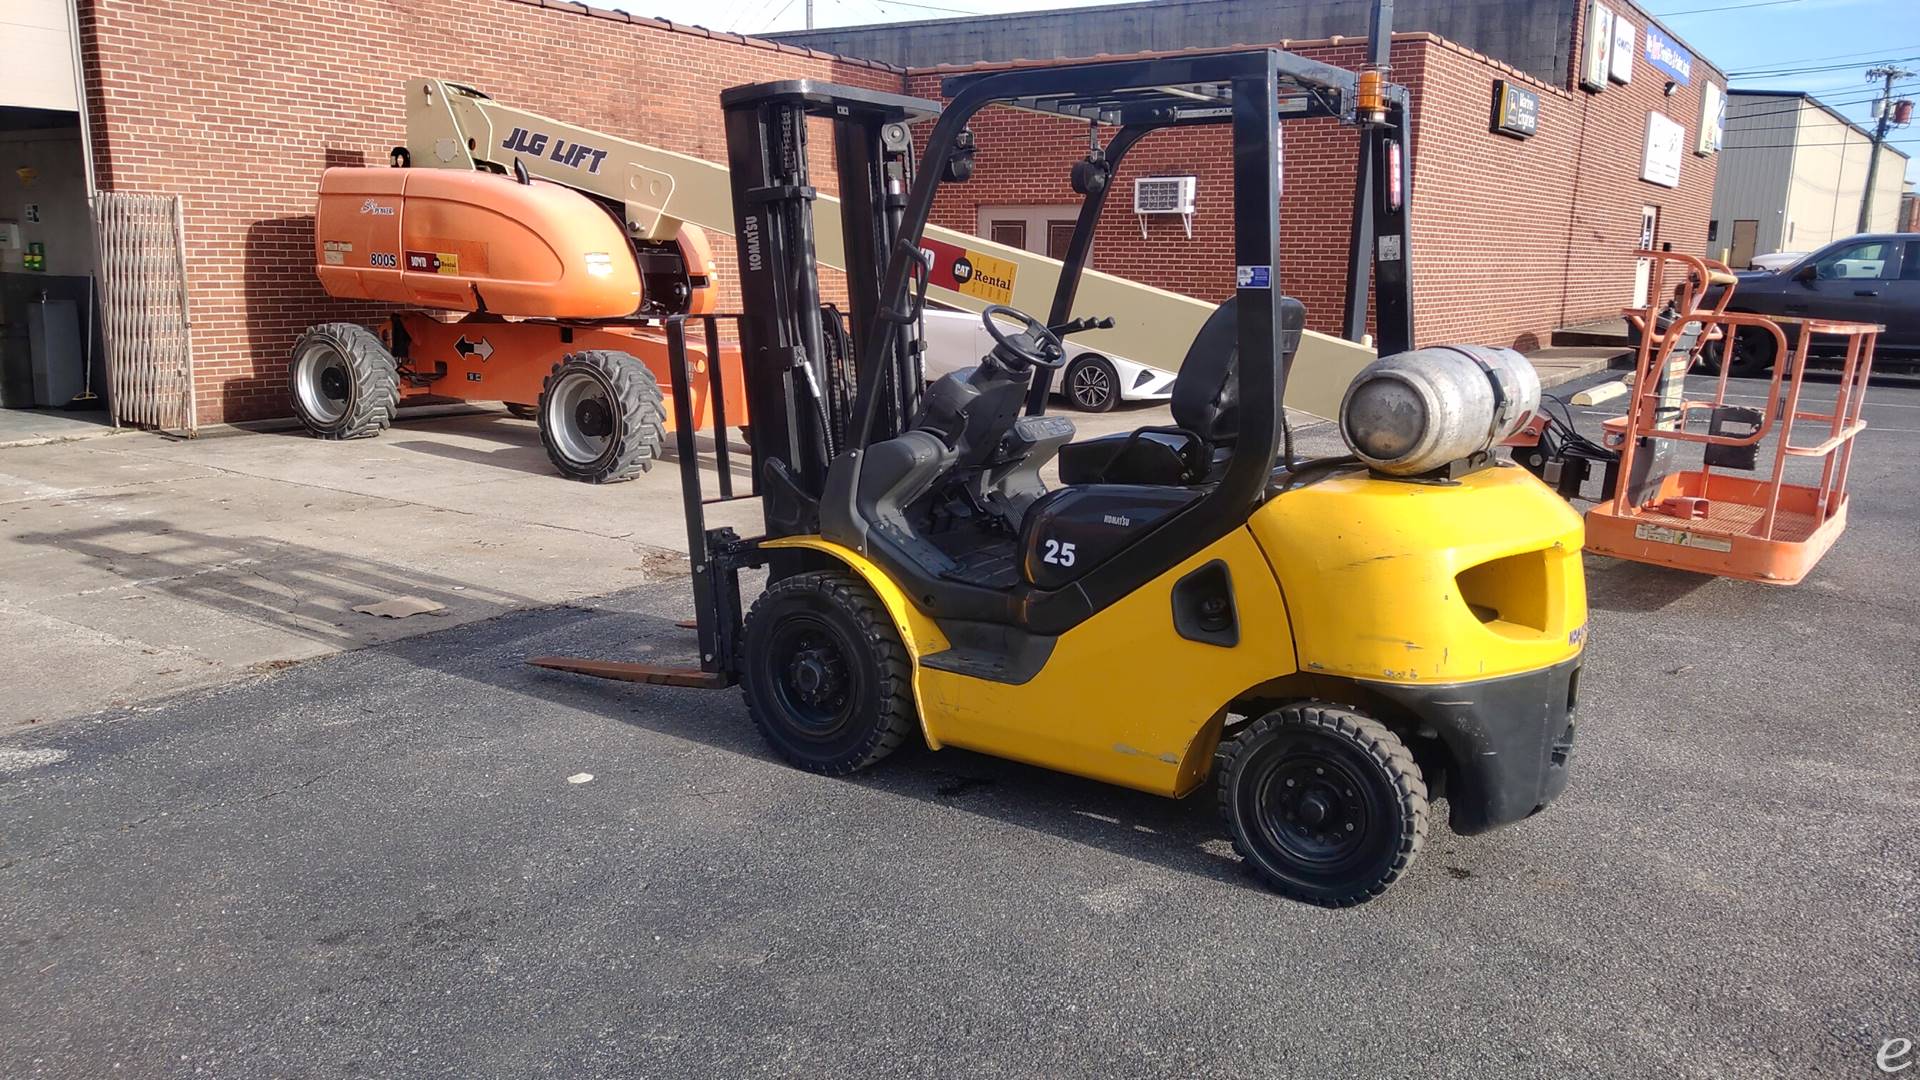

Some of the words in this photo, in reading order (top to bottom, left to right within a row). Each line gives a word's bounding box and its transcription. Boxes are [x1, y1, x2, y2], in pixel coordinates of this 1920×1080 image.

[501, 127, 549, 156] JLG
[550, 138, 608, 173] LIFT
[744, 215, 762, 271] KOMATSU
[370, 253, 397, 267] 800S
[954, 263, 970, 278] CAT
[974, 268, 1011, 290] Rental
[1103, 514, 1130, 527] KOMATSU
[1043, 539, 1076, 567] 25
